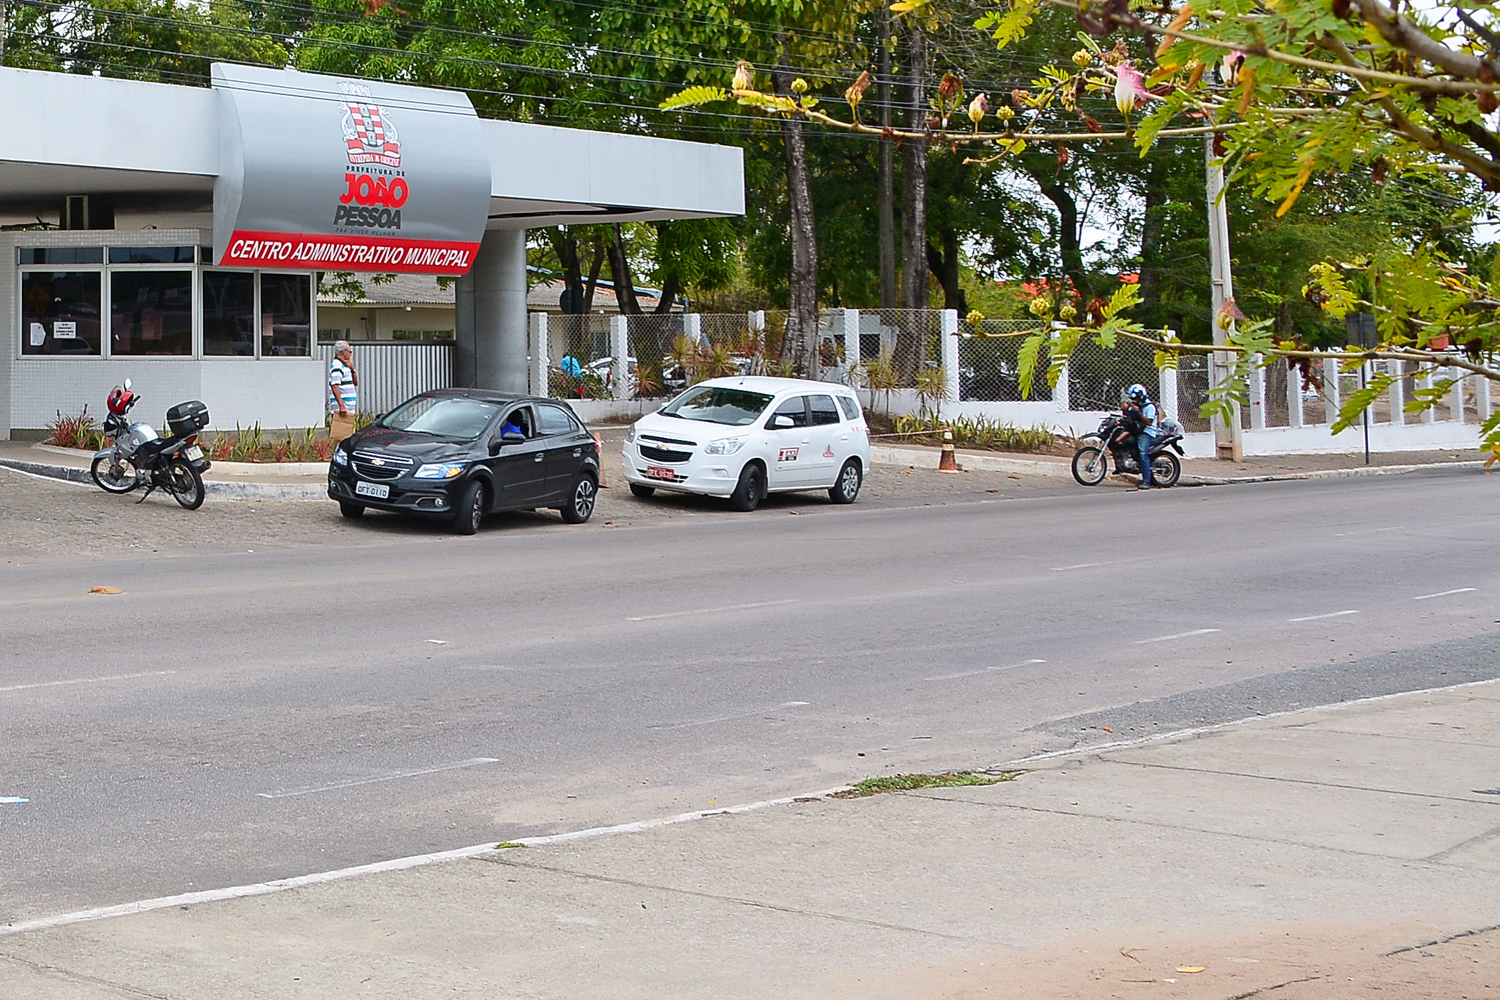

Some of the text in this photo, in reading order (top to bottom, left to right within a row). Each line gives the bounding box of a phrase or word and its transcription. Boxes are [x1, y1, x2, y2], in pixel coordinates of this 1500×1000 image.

[346, 165, 393, 176] PREFEITURA
[339, 173, 409, 209] JOÃO
[333, 205, 402, 230] PESSOA
[230, 239, 471, 267] CENTRO ADMINISTRATIVO MUNICIPAL
